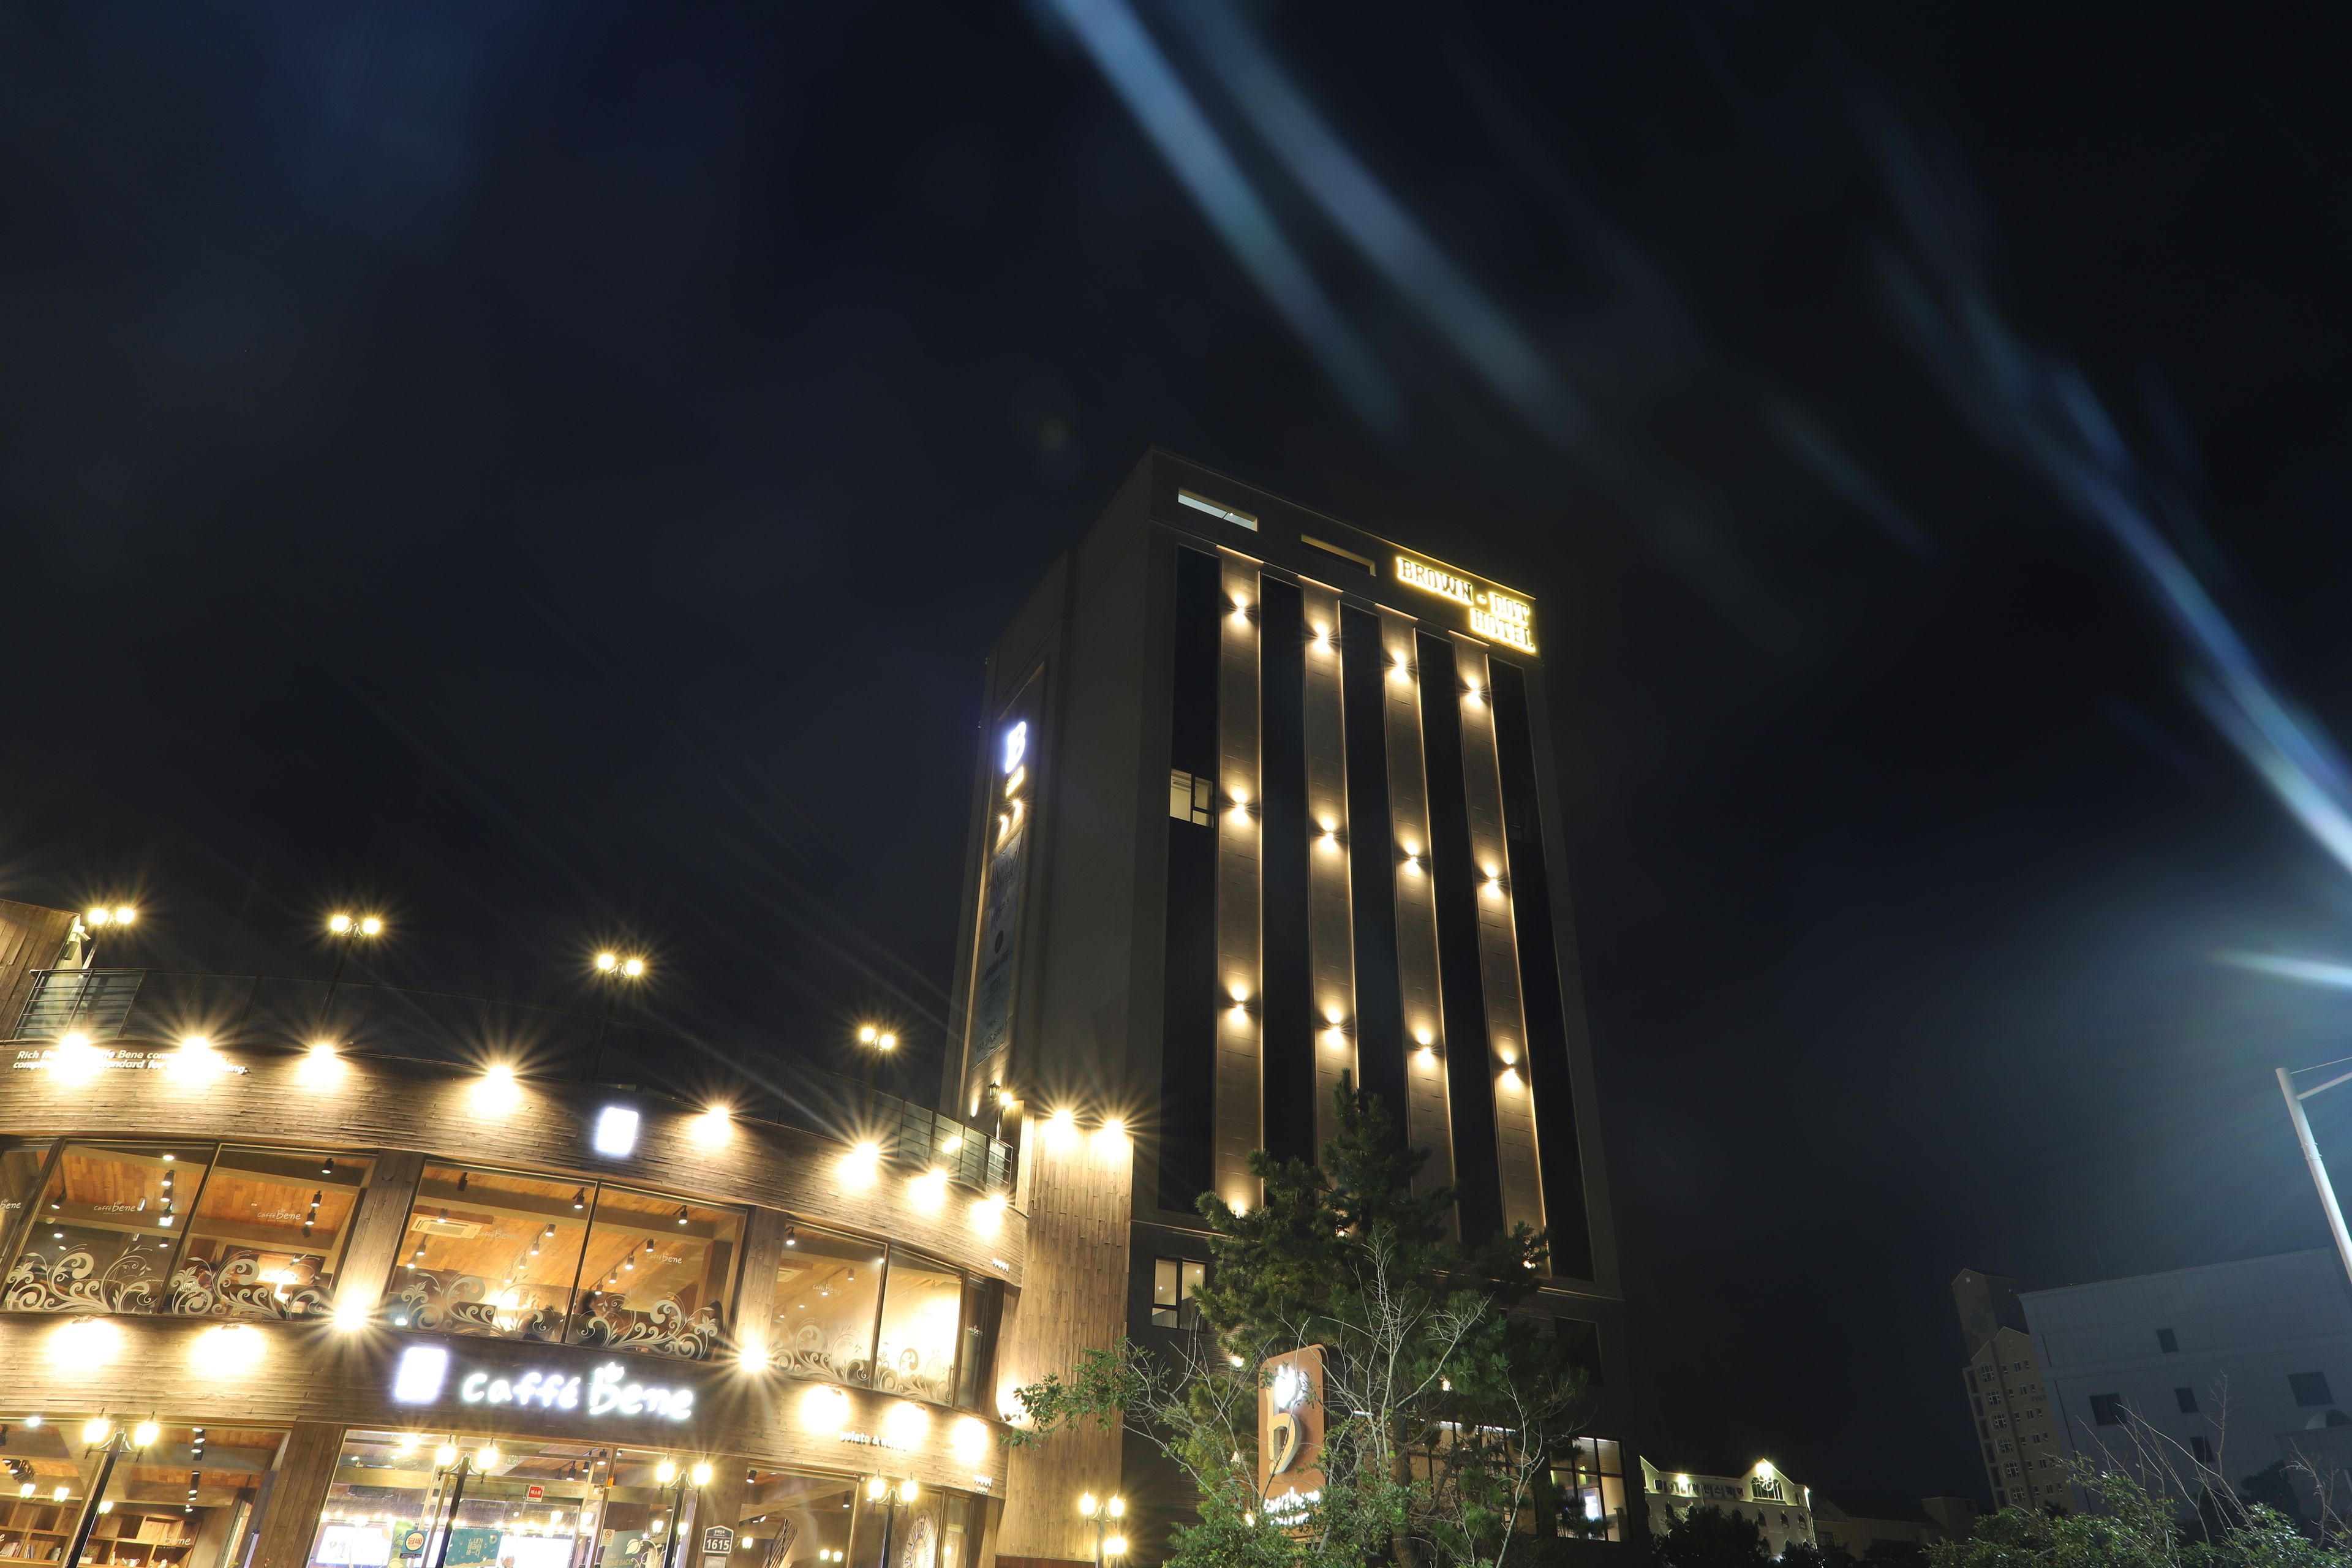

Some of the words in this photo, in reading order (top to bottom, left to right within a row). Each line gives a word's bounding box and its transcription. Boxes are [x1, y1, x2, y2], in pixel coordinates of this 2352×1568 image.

[1470, 608, 1536, 652] HOTEL
[17, 1050, 40, 1060] Rich
[117, 1049, 144, 1059] Bene
[707, 1539, 730, 1550] 1615
